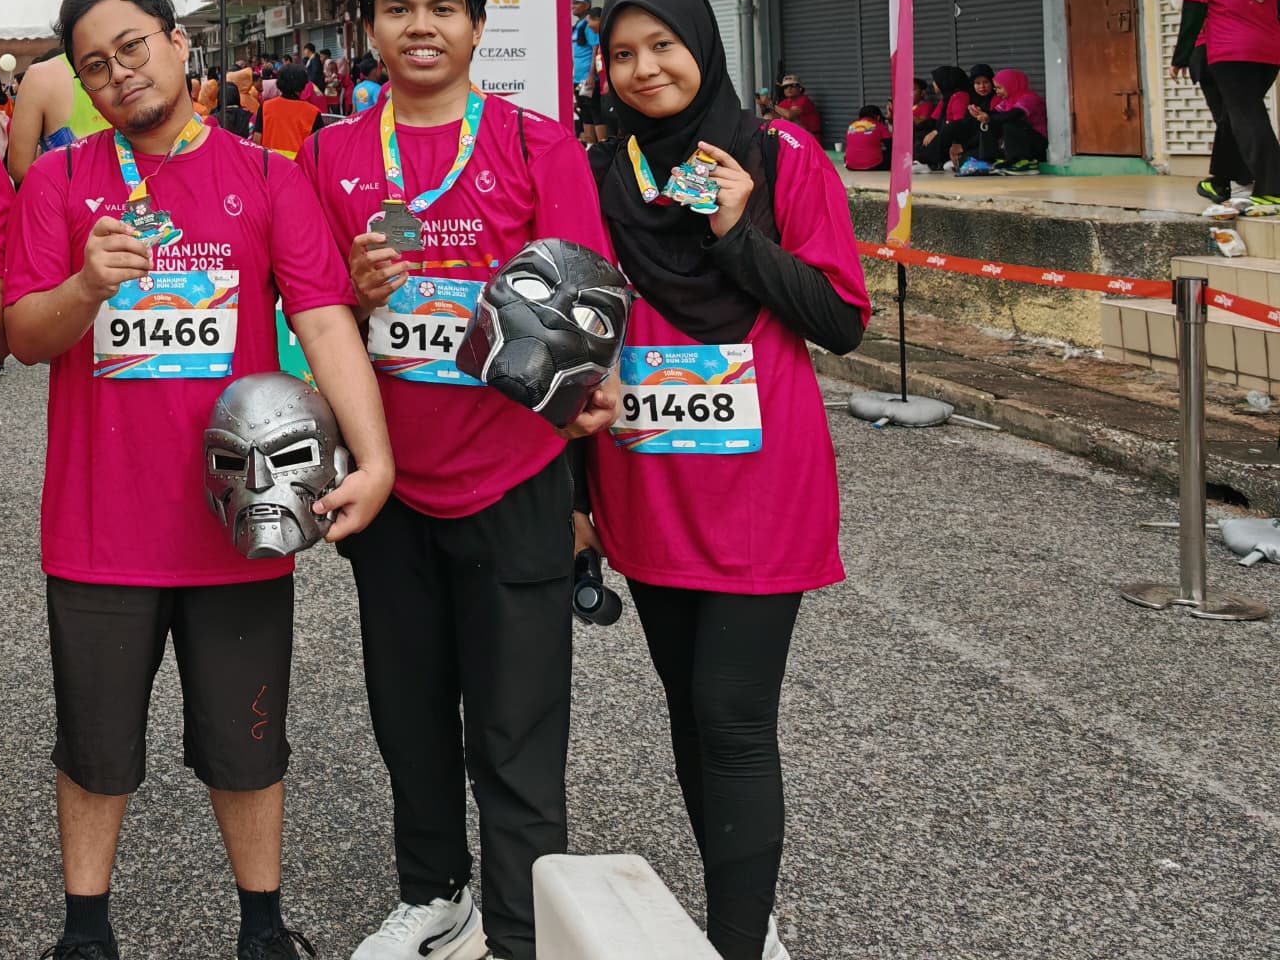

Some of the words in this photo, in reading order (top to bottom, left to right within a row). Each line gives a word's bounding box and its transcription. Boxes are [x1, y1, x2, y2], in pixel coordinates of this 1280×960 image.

[479, 48, 526, 58] CEZARS
[482, 79, 525, 91] Eucerin
[778, 130, 801, 149] TRON
[359, 182, 380, 191] VALE
[421, 218, 483, 233] ANJUNG
[441, 233, 477, 247] 2025
[157, 243, 232, 257] MANJUNG
[157, 257, 187, 270] RUN
[191, 257, 224, 271] 2025
[110, 317, 220, 348] 91466
[389, 321, 467, 353] 914
[623, 392, 735, 423] 91468
